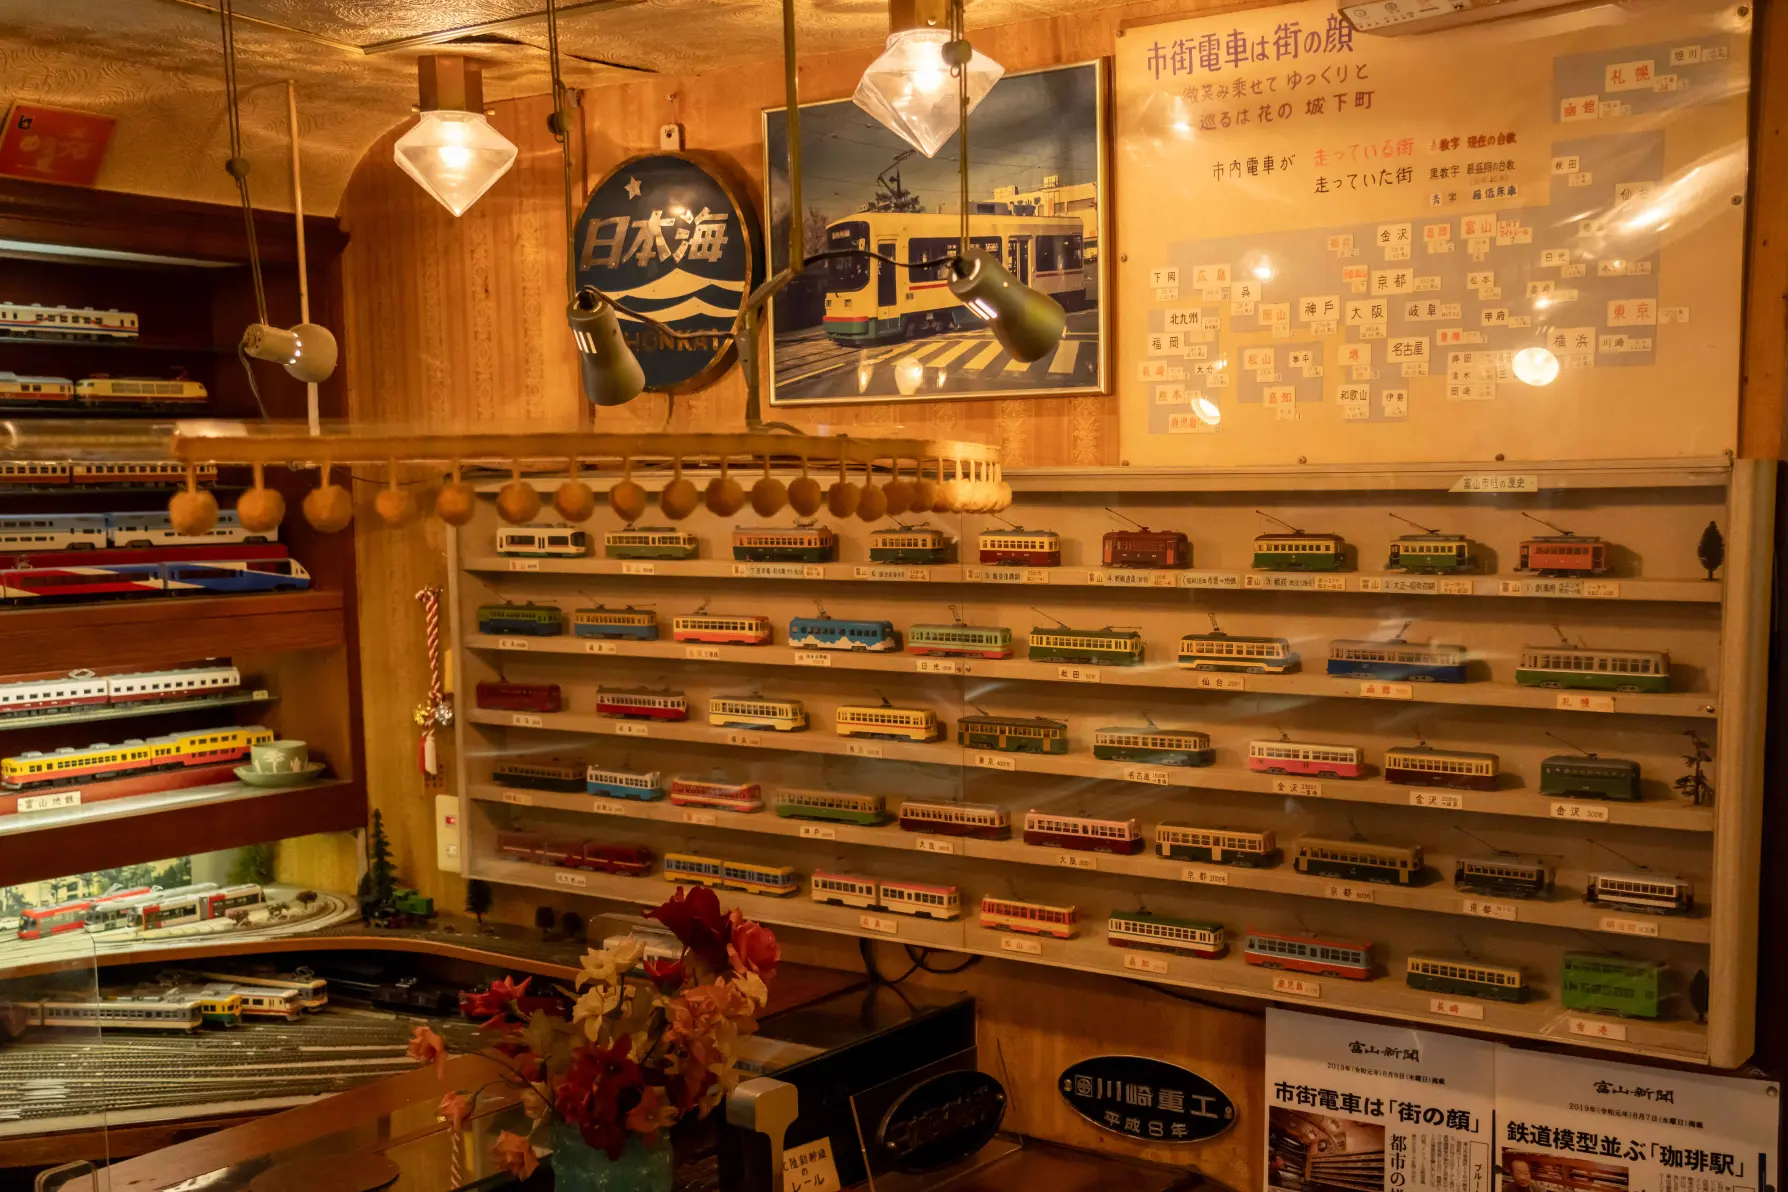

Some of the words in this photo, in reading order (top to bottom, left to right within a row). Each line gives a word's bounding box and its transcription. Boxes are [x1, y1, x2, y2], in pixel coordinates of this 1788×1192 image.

[1147, 13, 1353, 80] 市街電車は街の顔
[1287, 64, 1369, 90] ゆっくりと
[1200, 108, 1250, 130] 巡るは
[1258, 103, 1293, 123] 花の
[1305, 91, 1375, 115] 城下町
[1314, 138, 1415, 167] 走っている街
[1213, 154, 1296, 182] 市内電車が
[1554, 159, 1577, 171] 秋田
[1314, 166, 1413, 193] 走っていた街
[579, 206, 729, 272] 日本海
[1380, 228, 1409, 242] 金沢
[1377, 273, 1407, 290] 京都
[1304, 300, 1334, 316] 神戸
[1350, 305, 1385, 320] 大阪
[1408, 303, 1438, 318] 岐阜
[1613, 303, 1650, 321] 東京
[1169, 311, 1199, 326] 北九州
[1152, 336, 1179, 351] 福岡
[1391, 341, 1424, 357] 名古屋
[1553, 333, 1589, 349] 横浜
[1340, 389, 1368, 401] 和歌山
[1060, 669, 1080, 680] 秋田
[1202, 677, 1224, 688] 仙台
[1277, 782, 1298, 794] 金沢
[25, 793, 75, 809] 富山地鉄
[1415, 794, 1437, 805] 金沢
[1555, 805, 1581, 817] 金沢
[1187, 870, 1207, 881] 京都
[1330, 886, 1352, 897] 京都
[1348, 1041, 1420, 1062] 富山新聞
[1097, 1078, 1218, 1119] 川崎重工
[1593, 1080, 1674, 1104] 富山新聞
[1274, 1080, 1480, 1134] 市街電車は「街の顔」
[1507, 1120, 1745, 1178] 鉄道模型並ぶ「珈琲駅」
[801, 1167, 808, 1176] の
[1473, 1163, 1483, 1192] ブルー
